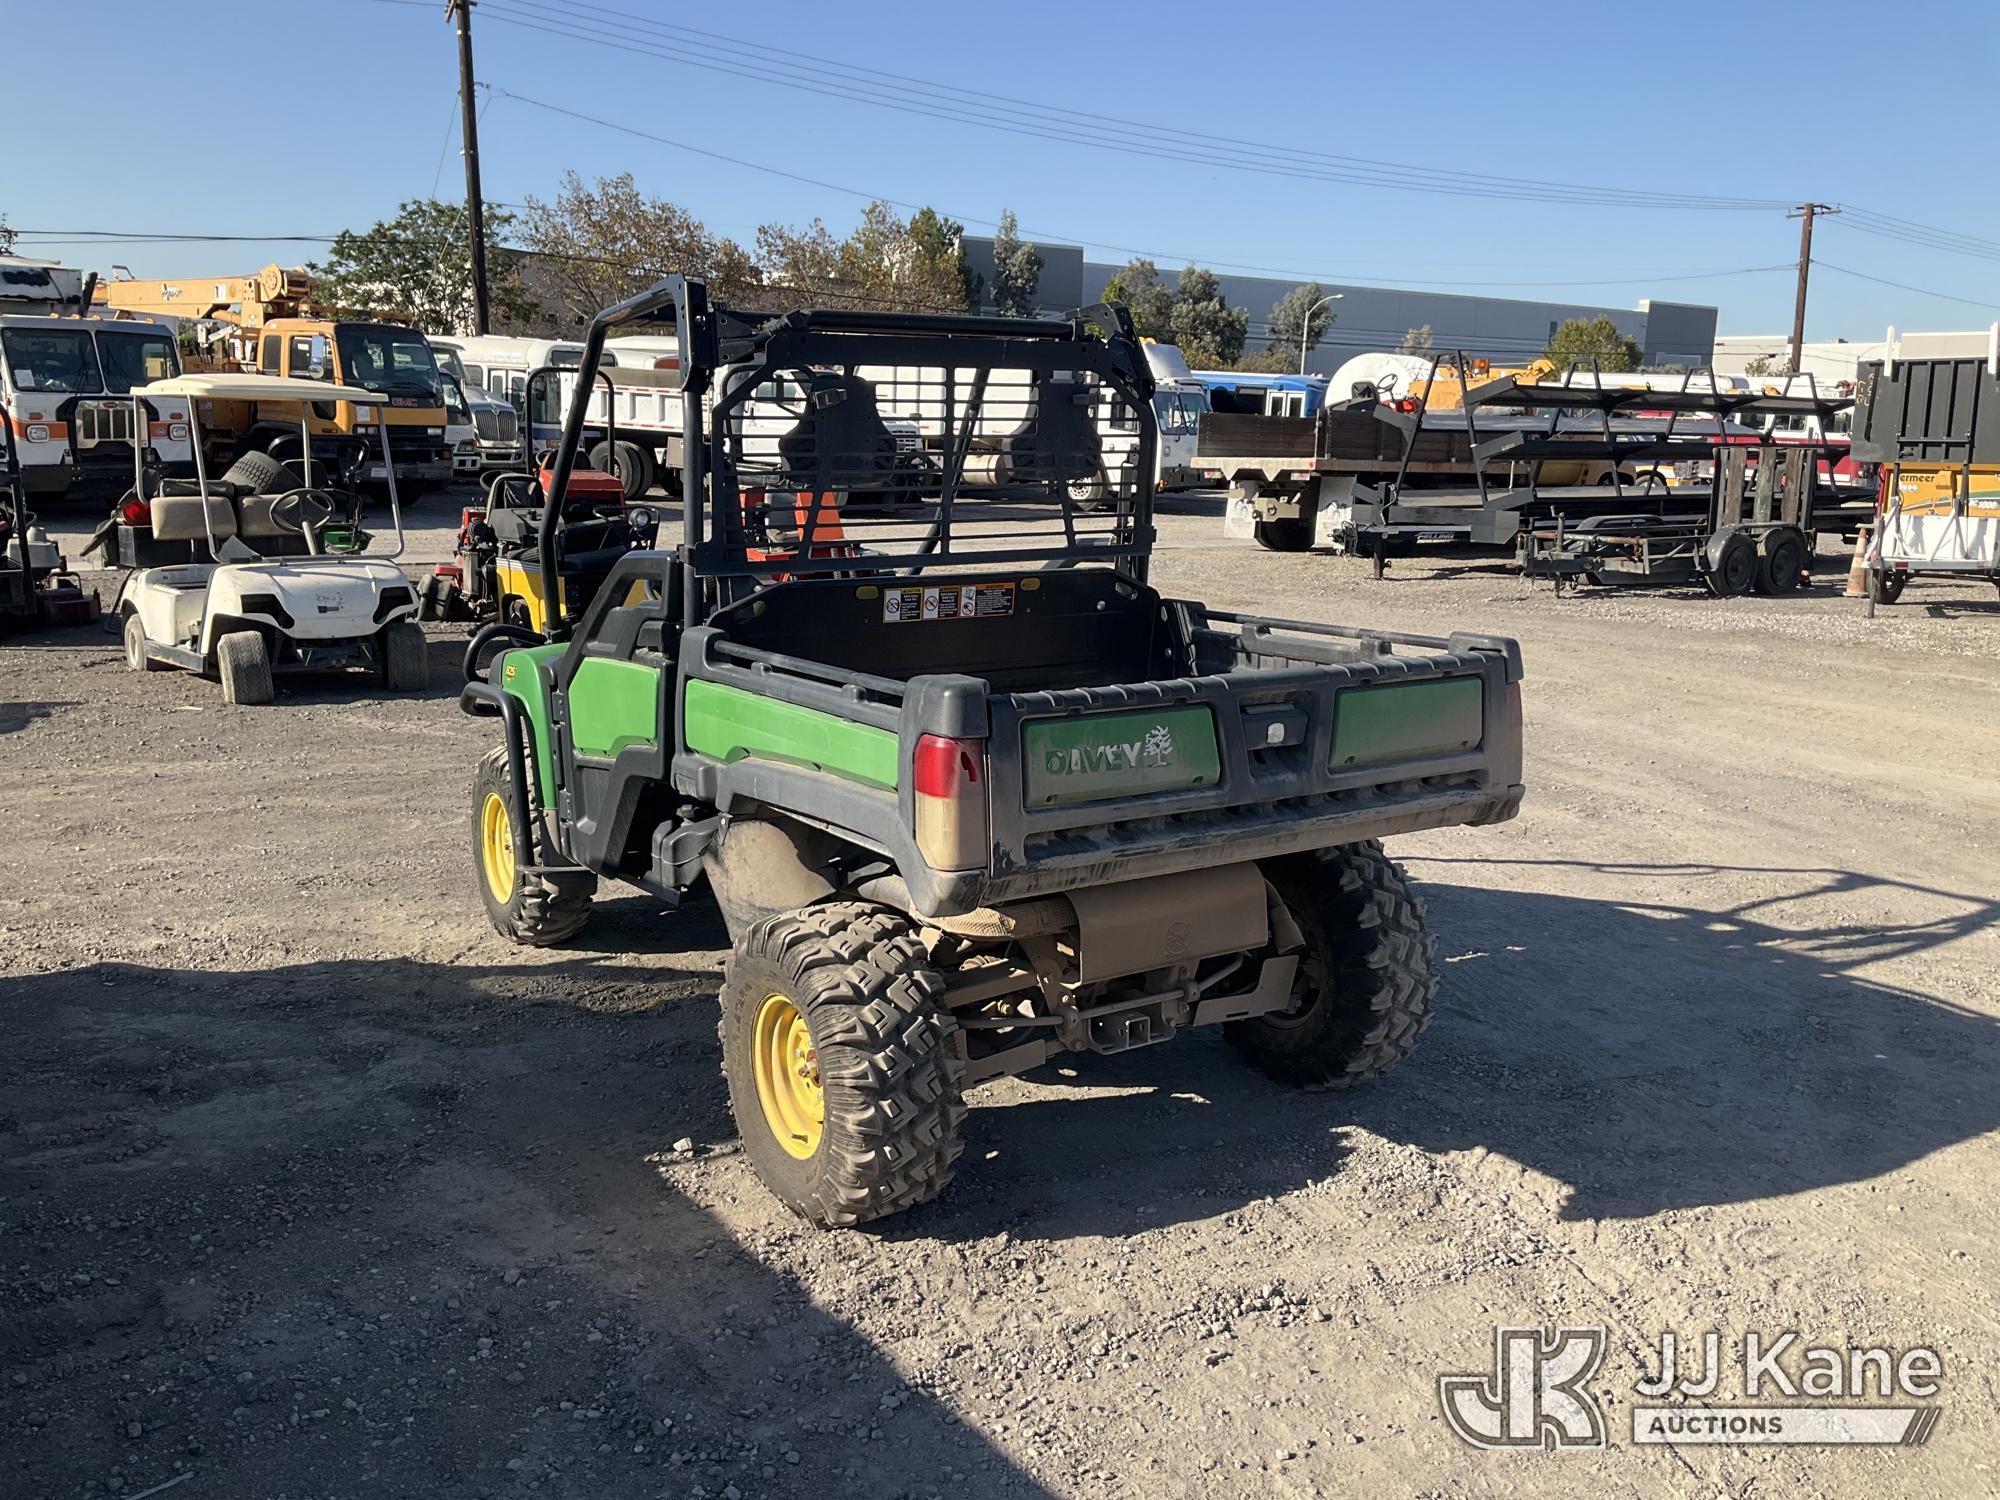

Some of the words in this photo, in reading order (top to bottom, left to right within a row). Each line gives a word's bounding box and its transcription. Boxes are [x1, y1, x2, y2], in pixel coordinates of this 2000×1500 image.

[392, 397, 417, 407] GMC
[1900, 474, 1935, 483] ermeer
[1045, 742, 1142, 775] DAVEY
